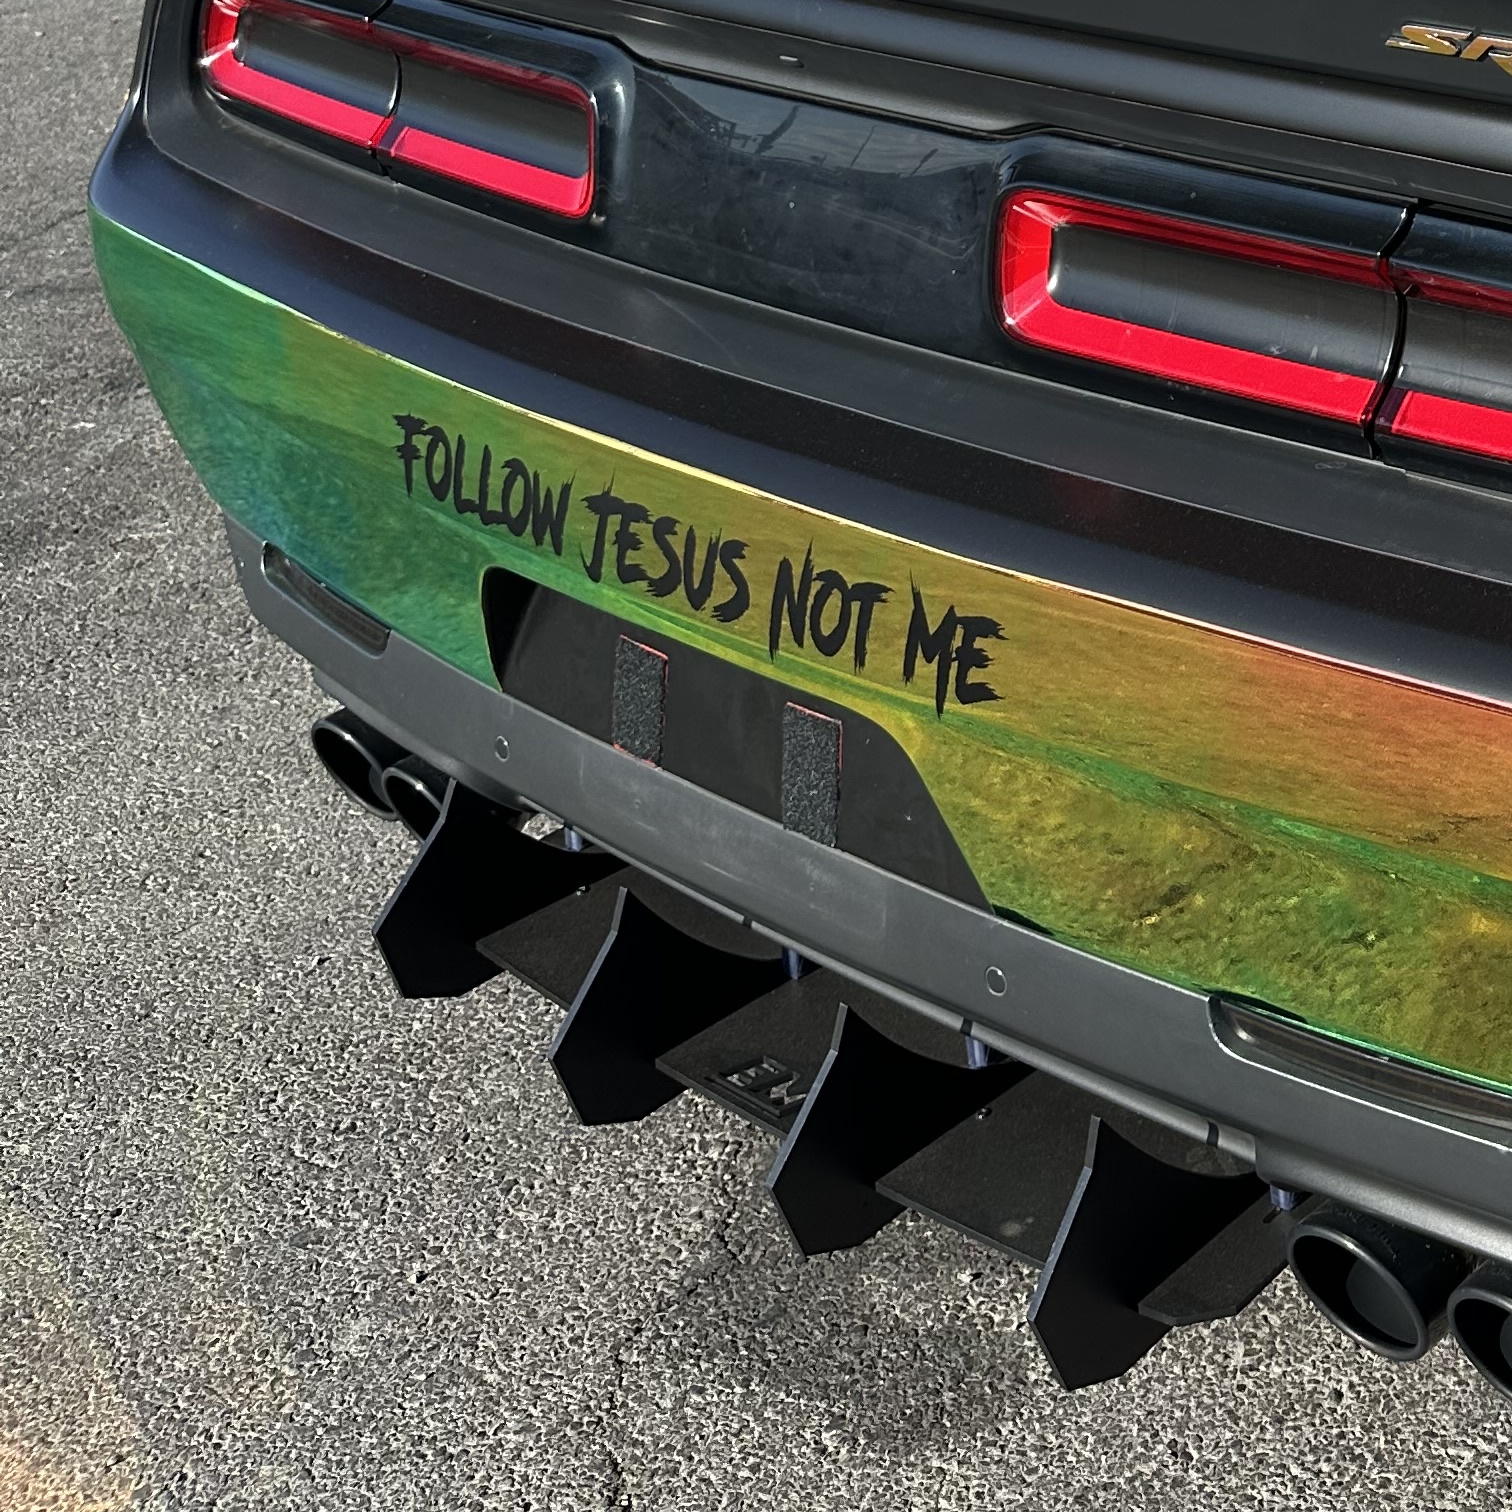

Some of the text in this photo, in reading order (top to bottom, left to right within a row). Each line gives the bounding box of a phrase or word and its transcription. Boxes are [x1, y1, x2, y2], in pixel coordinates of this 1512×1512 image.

[392, 412, 1010, 721] FOLLOW JESUS NOT ME
